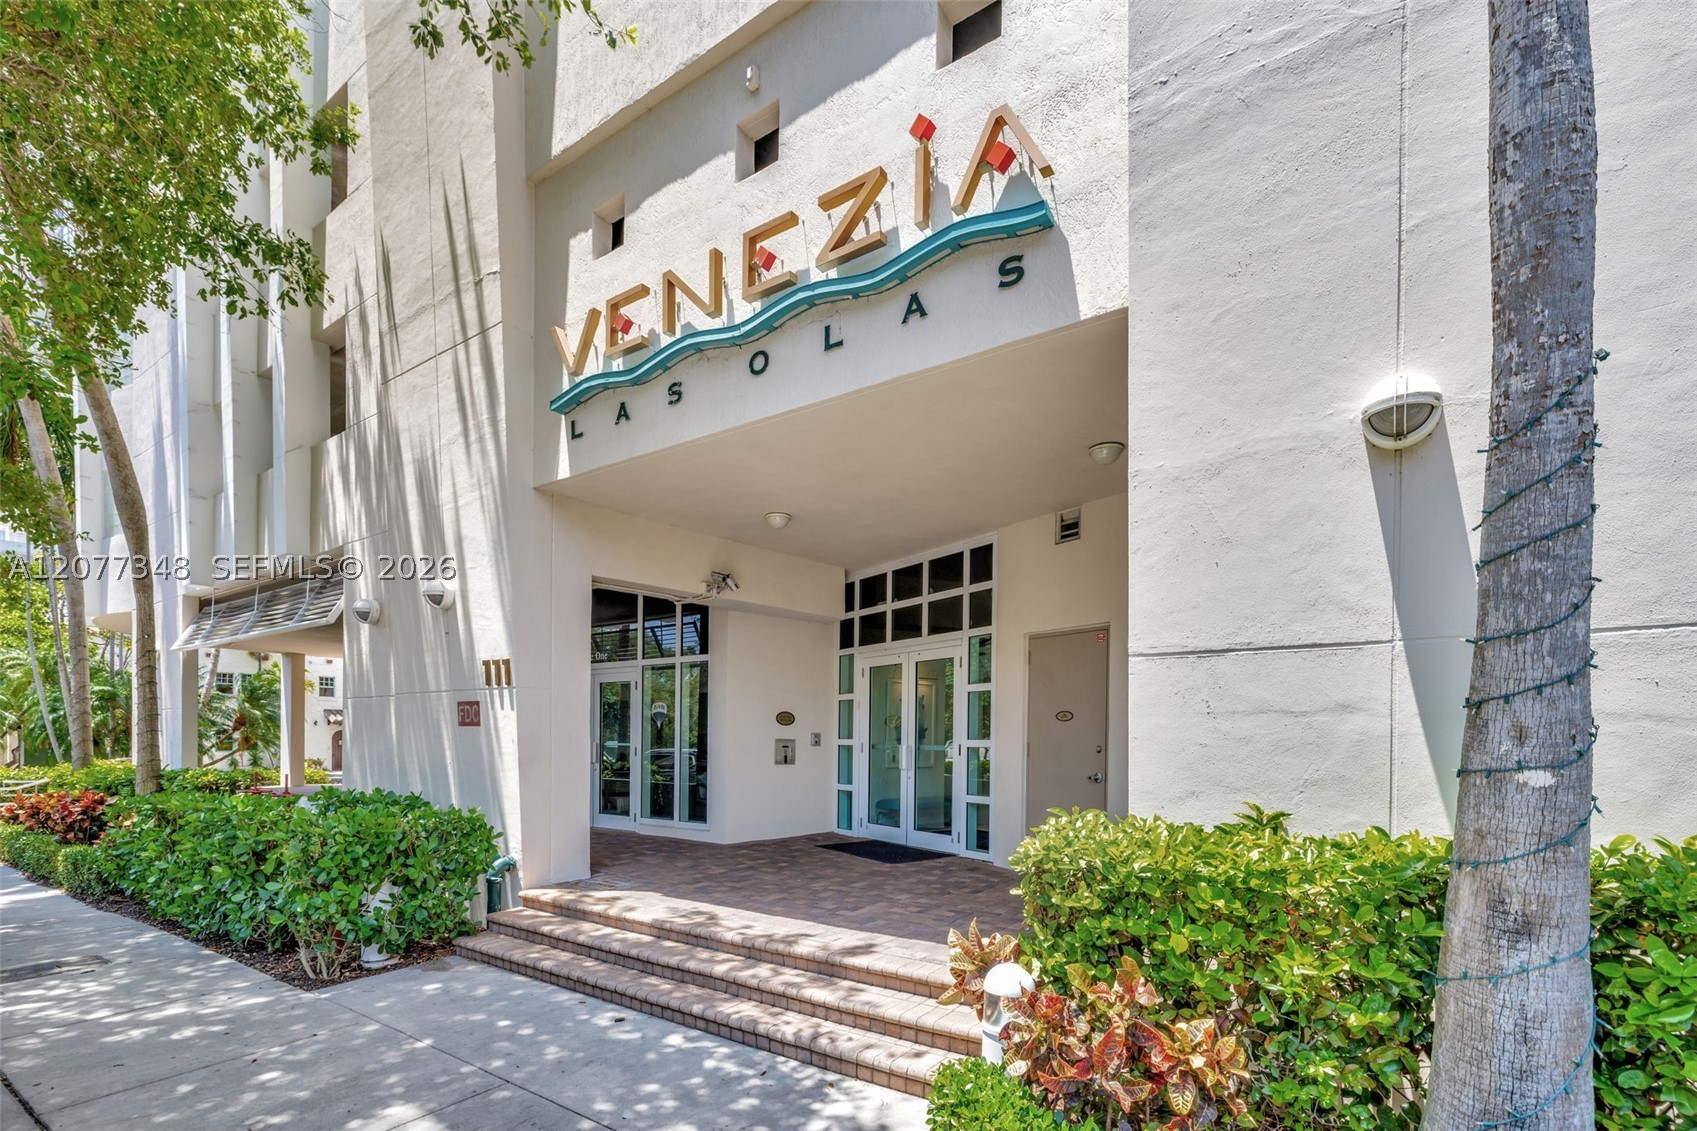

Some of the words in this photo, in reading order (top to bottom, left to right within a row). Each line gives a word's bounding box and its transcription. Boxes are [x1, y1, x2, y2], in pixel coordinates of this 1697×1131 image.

[550, 103, 1054, 377] VENEZIA
[570, 381, 683, 439] LAS
[748, 254, 1025, 376] OLAS
[458, 704, 480, 723] FDC
[482, 658, 511, 687] 111
